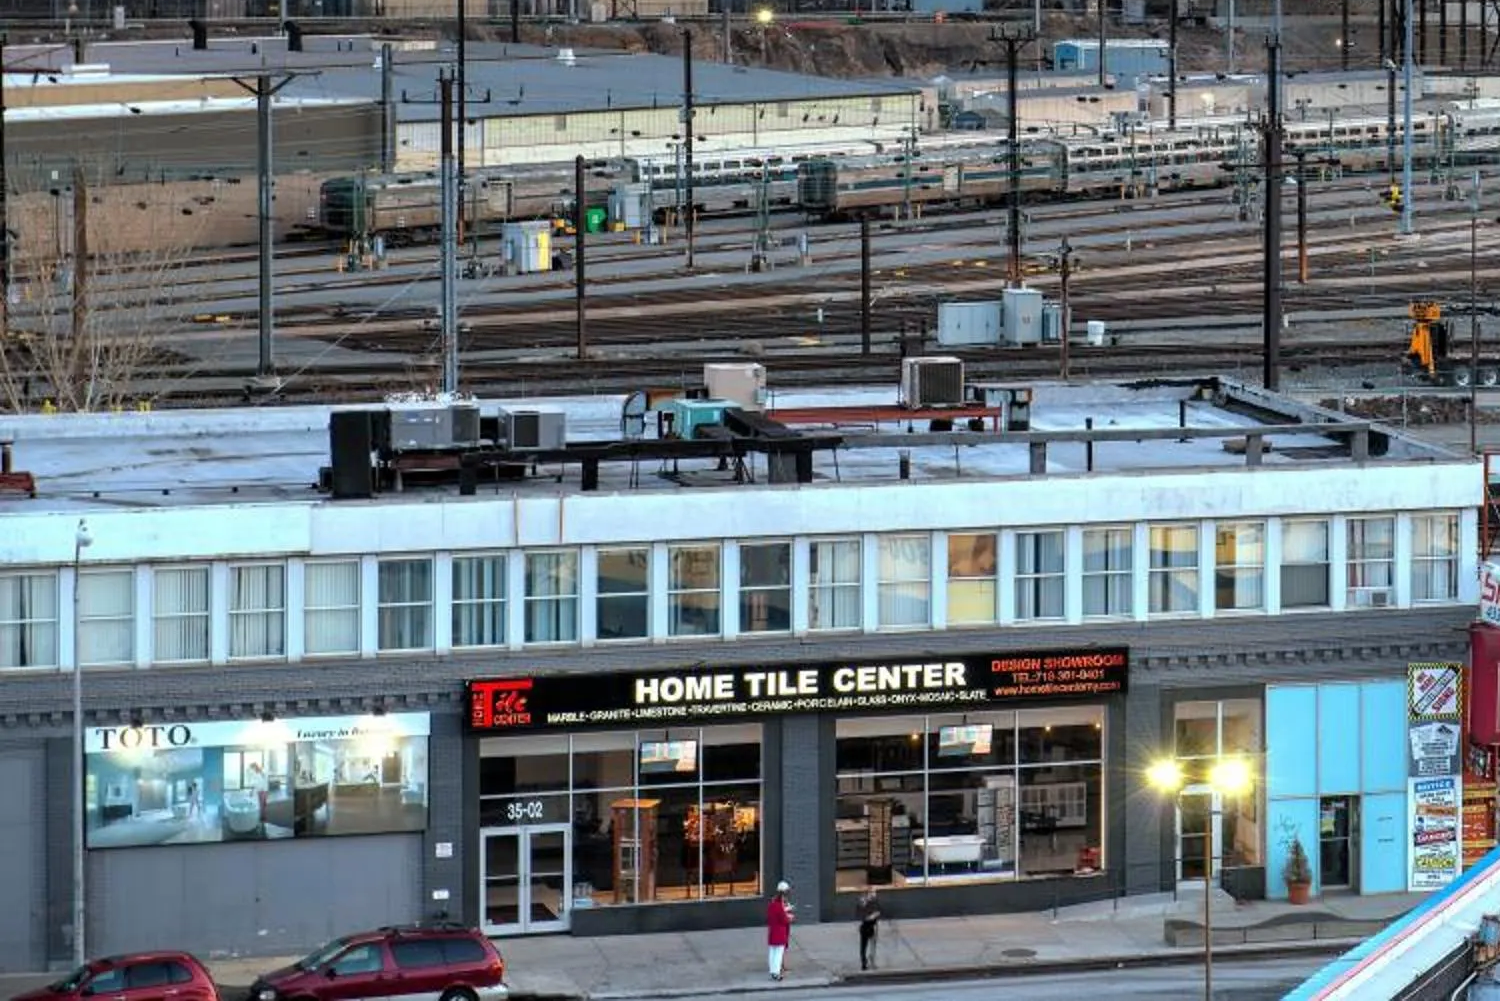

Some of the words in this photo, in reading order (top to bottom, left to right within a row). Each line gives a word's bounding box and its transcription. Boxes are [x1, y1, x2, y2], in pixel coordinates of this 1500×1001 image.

[991, 658, 1041, 672] DESIGN
[1043, 654, 1124, 670] SHOWROOM
[635, 673, 735, 704] HOME
[743, 670, 819, 697] TILE
[832, 662, 968, 693] CENTER
[96, 724, 192, 750] TOTO
[507, 802, 543, 820] 35-02
